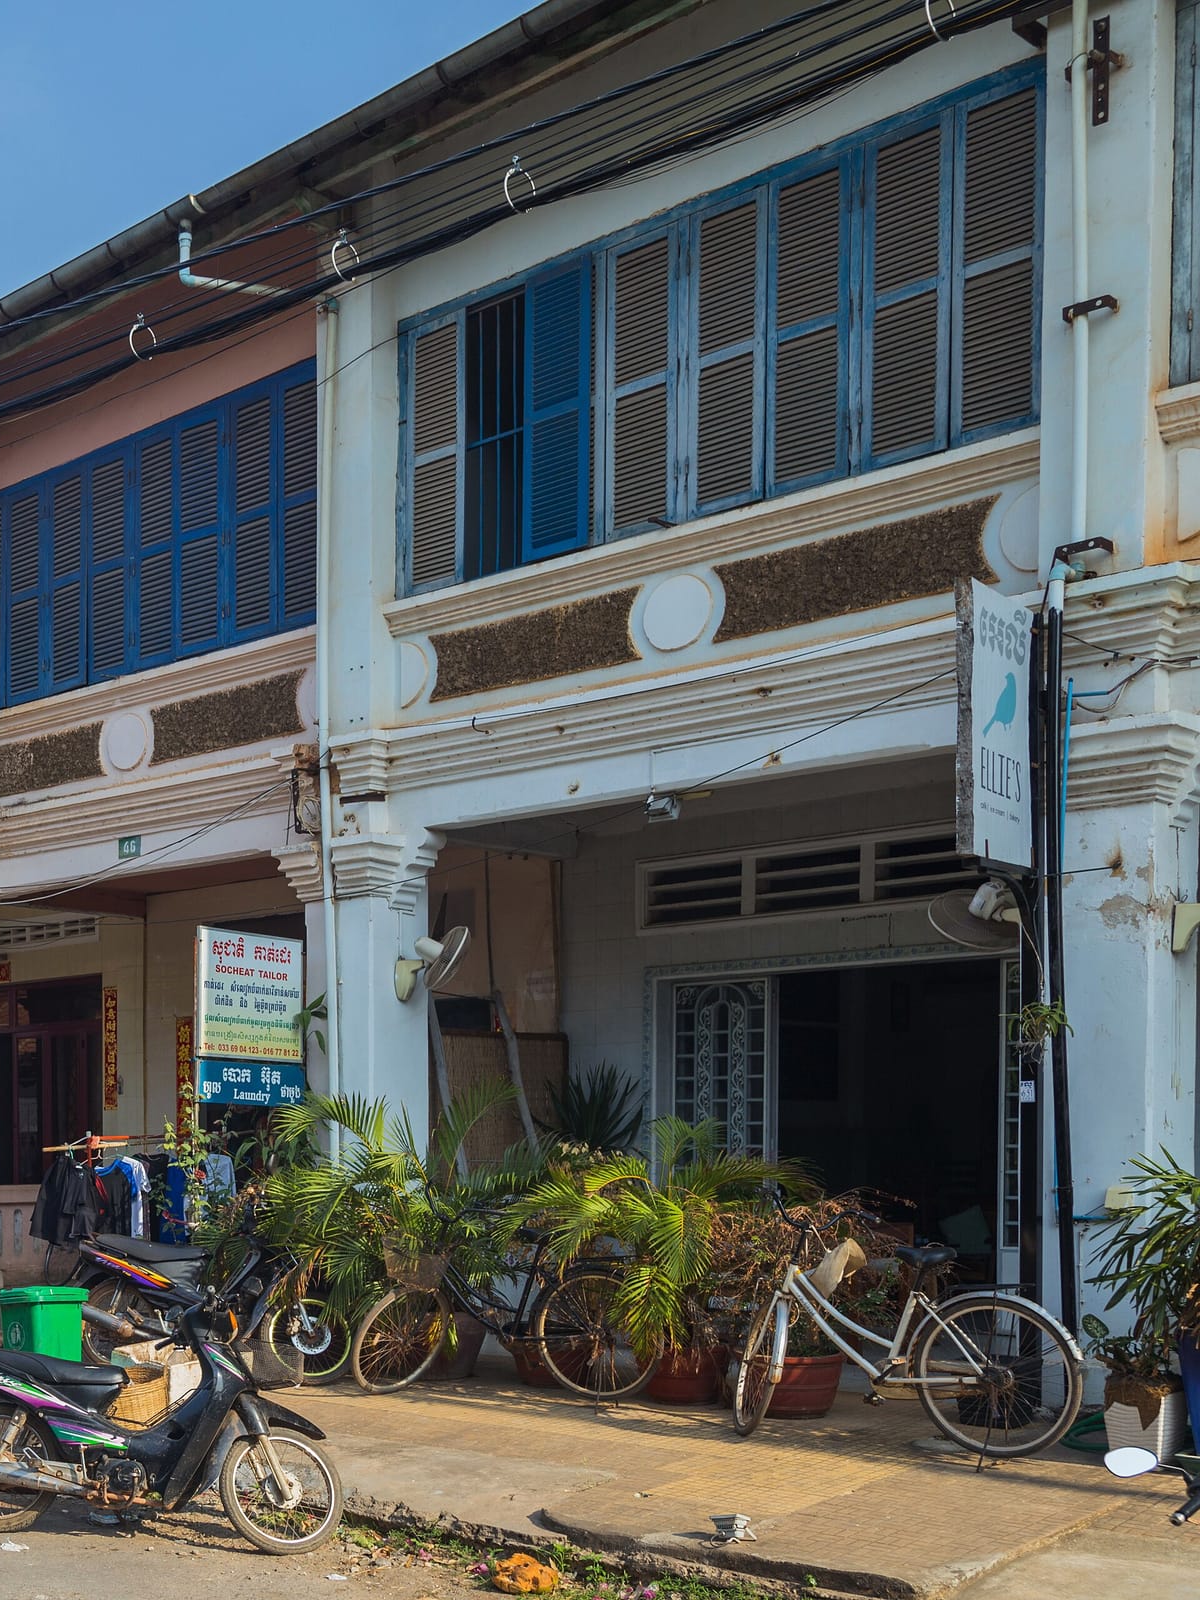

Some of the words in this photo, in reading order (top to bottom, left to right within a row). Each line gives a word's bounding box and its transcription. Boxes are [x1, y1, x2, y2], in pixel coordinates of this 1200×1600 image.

[981, 746, 1021, 803] ELLIE'S
[215, 964, 255, 977] SOCHEAT
[258, 970, 288, 981] TAILOR
[218, 1043, 229, 1052] 033
[231, 1044, 238, 1052] 69
[240, 1045, 247, 1053] 04
[275, 1048, 282, 1056] 77
[292, 1049, 299, 1057] 22
[233, 1088, 270, 1105] Laundry
